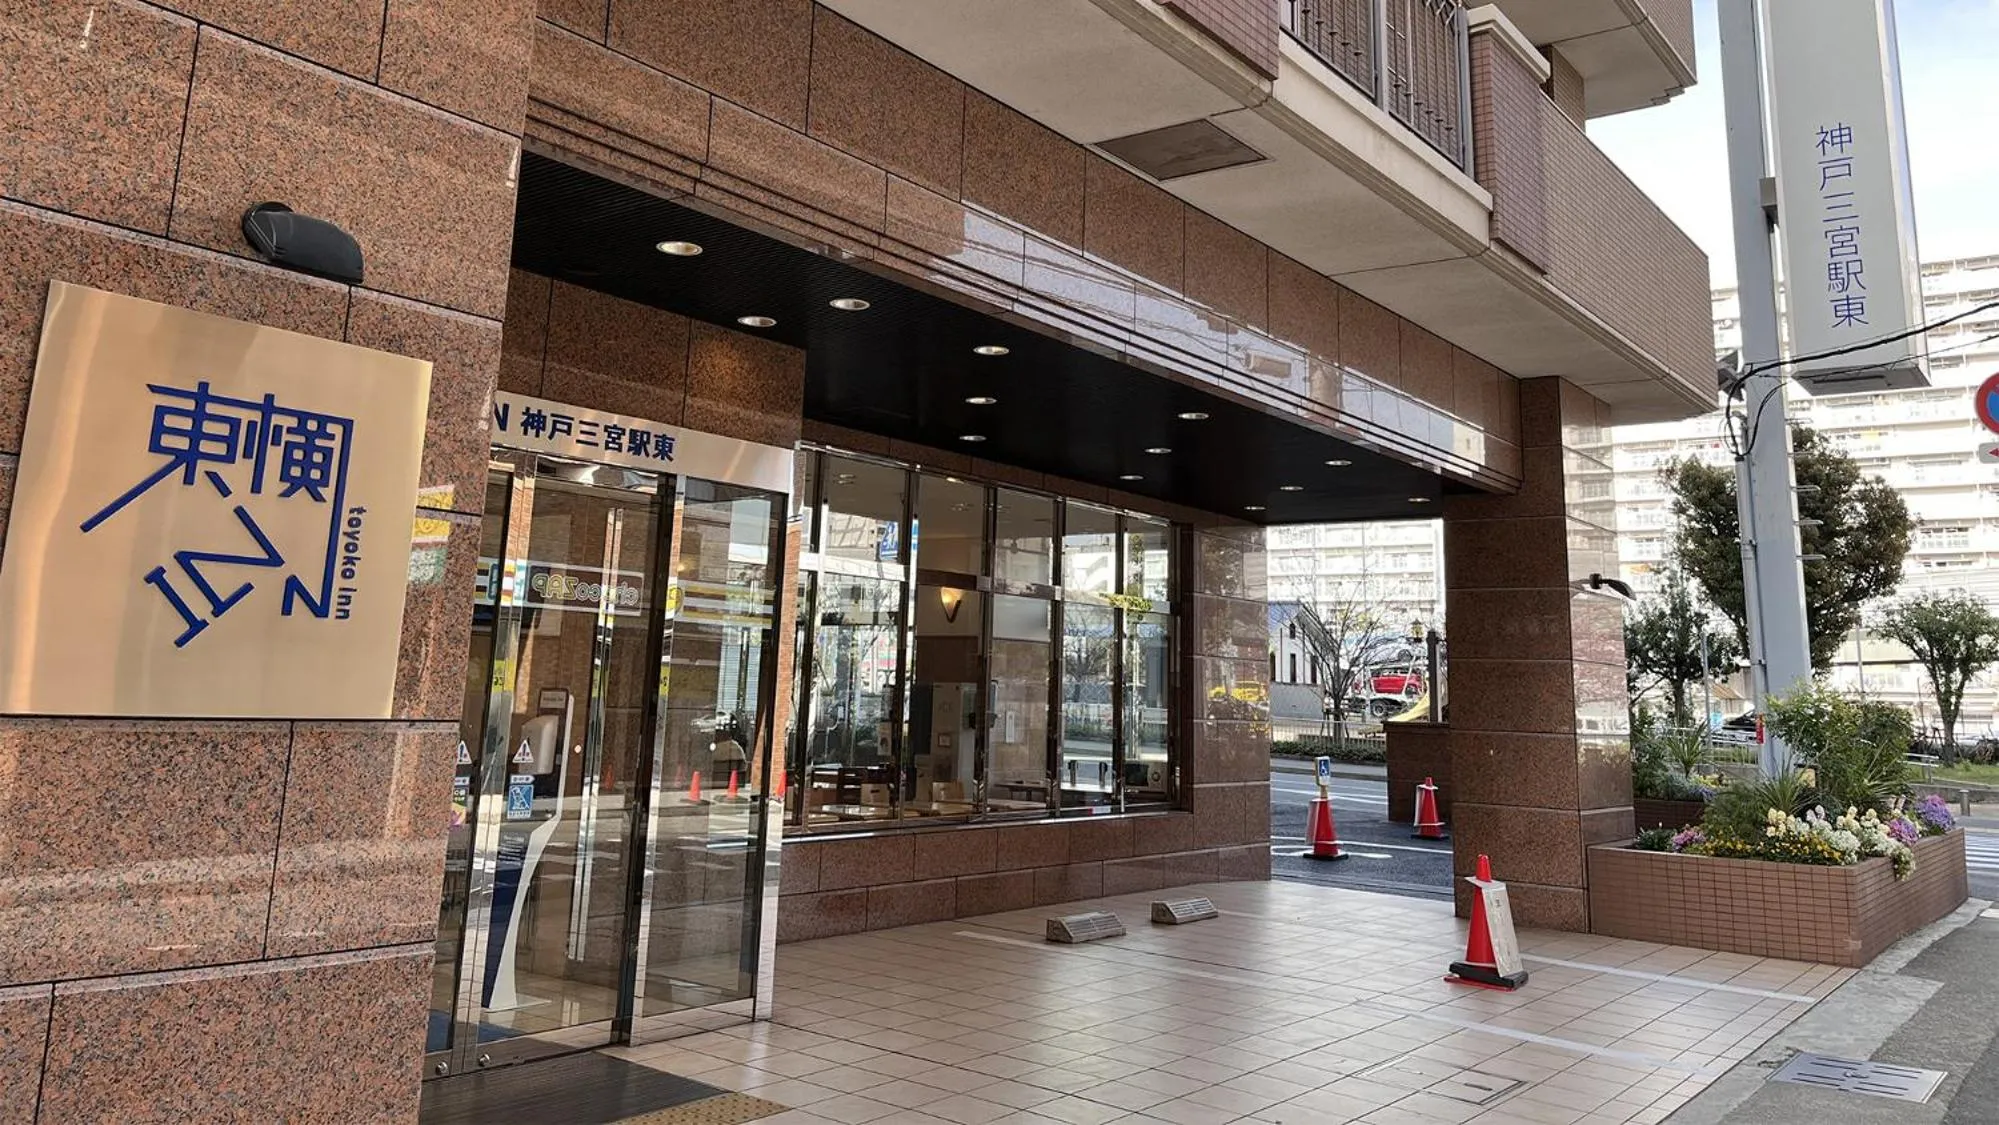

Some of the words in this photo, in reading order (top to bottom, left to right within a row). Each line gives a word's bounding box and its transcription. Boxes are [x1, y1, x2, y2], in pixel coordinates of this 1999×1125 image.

[1815, 122, 1869, 328] 神戸三宮駅東
[520, 406, 676, 462] 神戸三宮駅東
[341, 506, 367, 580] toyoko
